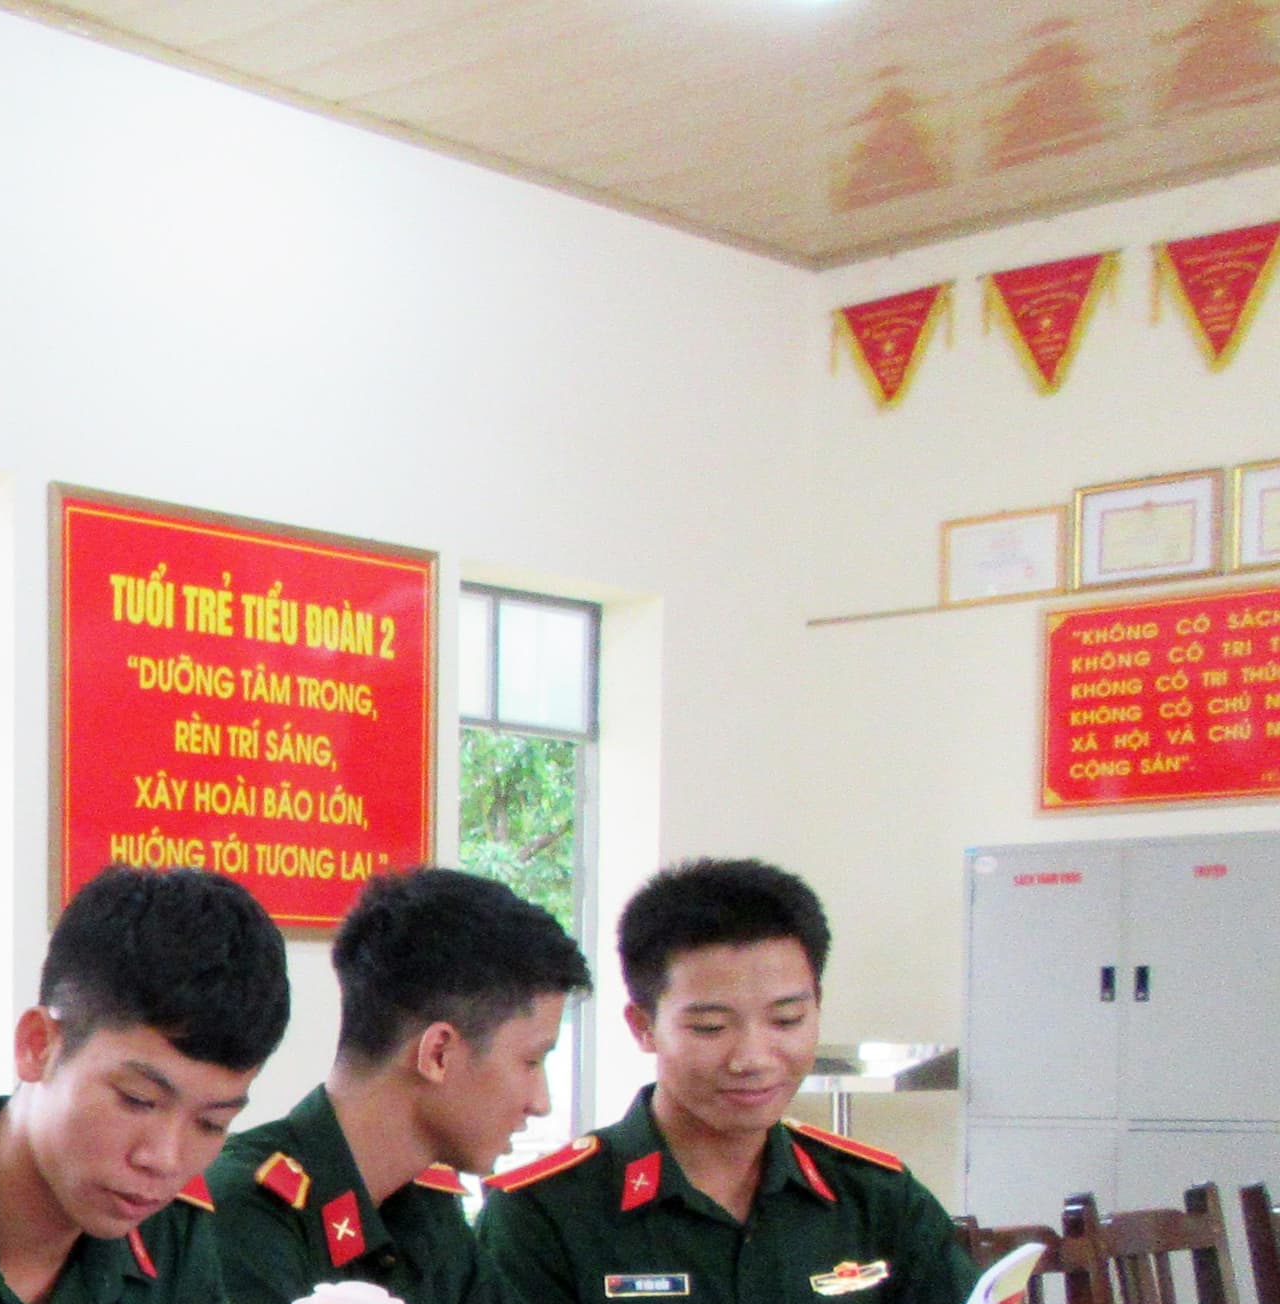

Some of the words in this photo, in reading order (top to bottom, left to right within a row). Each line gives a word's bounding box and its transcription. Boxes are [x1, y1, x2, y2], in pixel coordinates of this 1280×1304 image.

[109, 562, 175, 629] TUỔI
[182, 571, 234, 637] TRẺ
[241, 580, 299, 646] TIỂU
[305, 599, 374, 657] ĐOÀN
[380, 617, 396, 660] 2
[1071, 650, 1151, 674] KHÔNG
[1071, 678, 1143, 700] KHÔNG
[240, 663, 291, 706] TÂM
[297, 676, 378, 721] TRONG,
[1070, 705, 1143, 727] KHÔNG
[174, 711, 221, 756] RÈN
[227, 718, 260, 760] TRÍ
[265, 722, 338, 773] SÁNG,
[134, 769, 188, 811] XÂY
[194, 775, 257, 817] HOÀI
[263, 781, 313, 822] BÃO
[319, 785, 369, 831] LỚN,
[110, 826, 206, 869] HƯỚNG
[211, 832, 249, 874] TỚI
[254, 842, 336, 880] TƯƠNG
